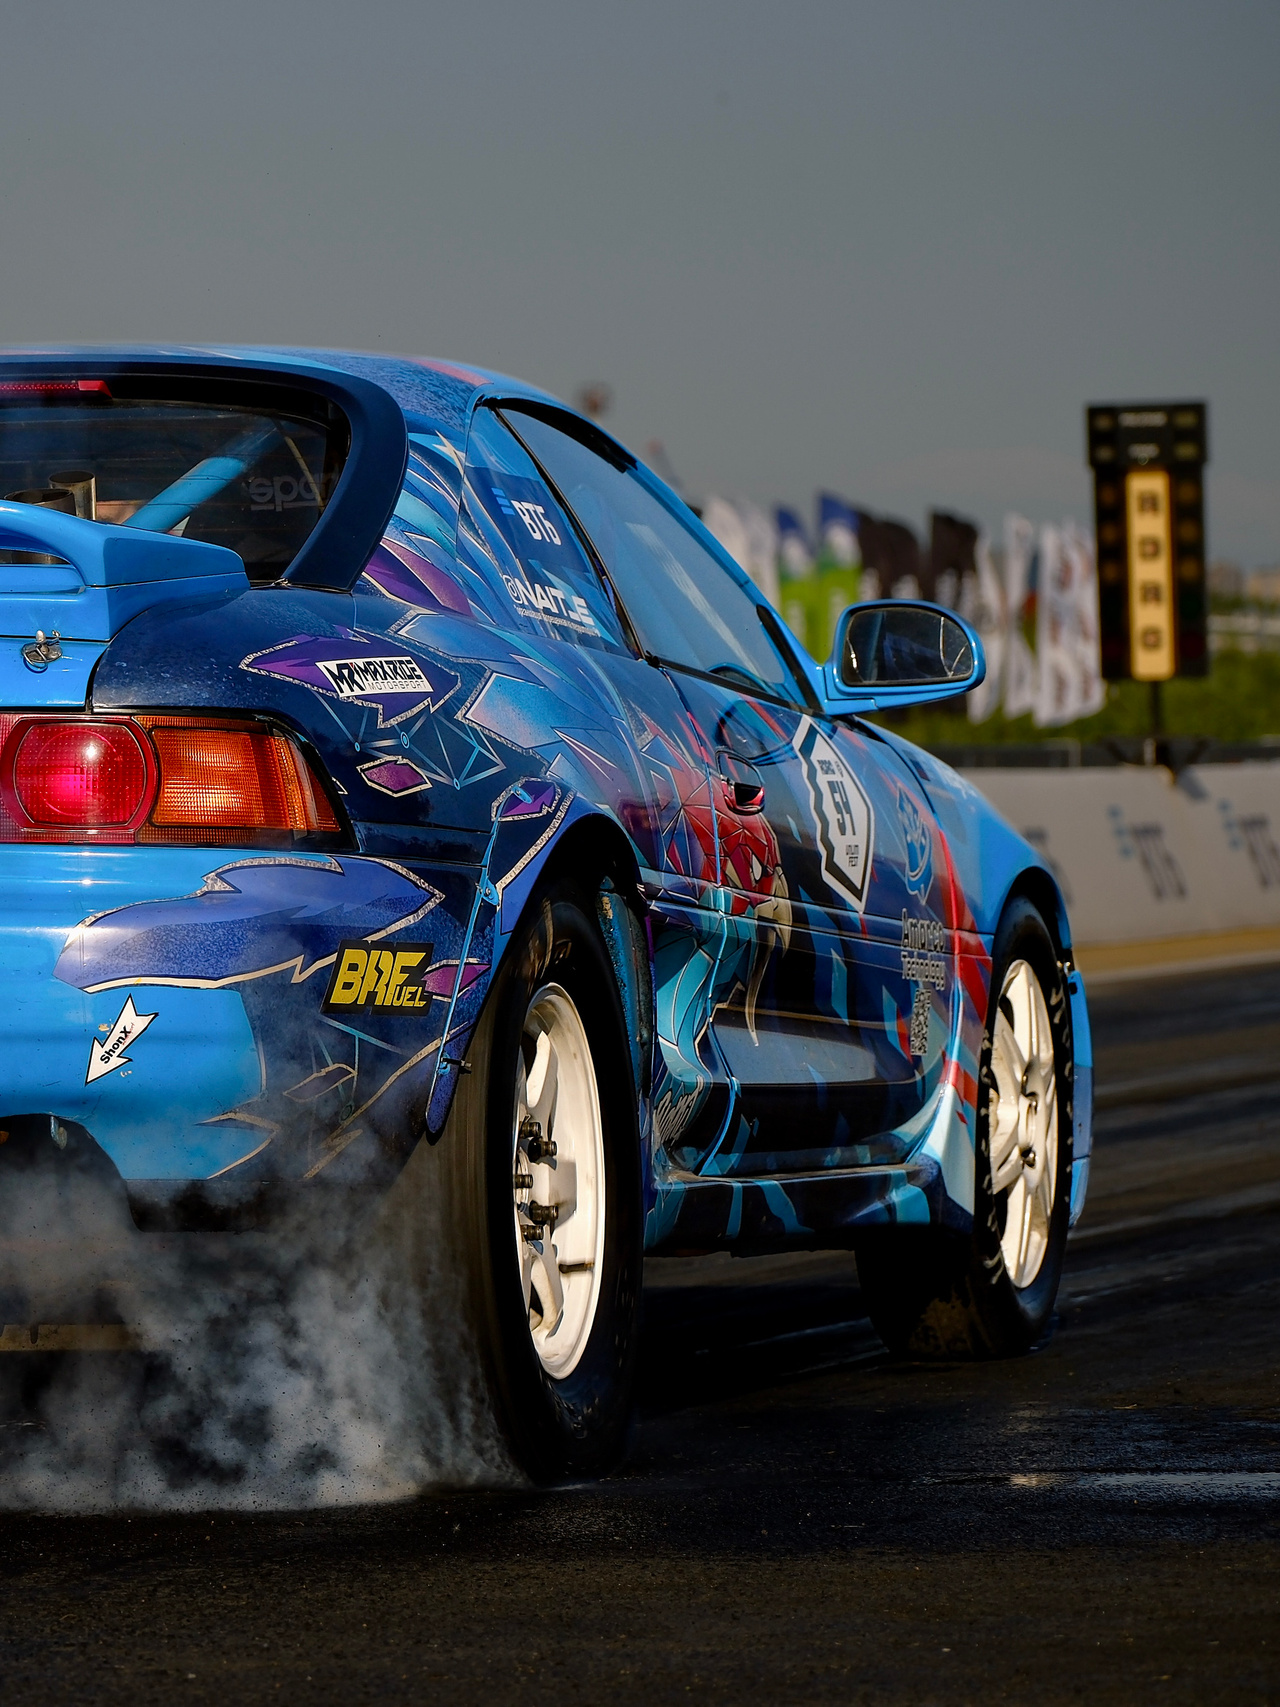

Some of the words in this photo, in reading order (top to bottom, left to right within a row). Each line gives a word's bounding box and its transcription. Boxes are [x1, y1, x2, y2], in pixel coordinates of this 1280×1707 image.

[367, 681, 428, 690] MOTORSPORT
[827, 781, 856, 836] 54
[901, 952, 946, 991] Technology
[100, 1025, 132, 1065] ShonX
